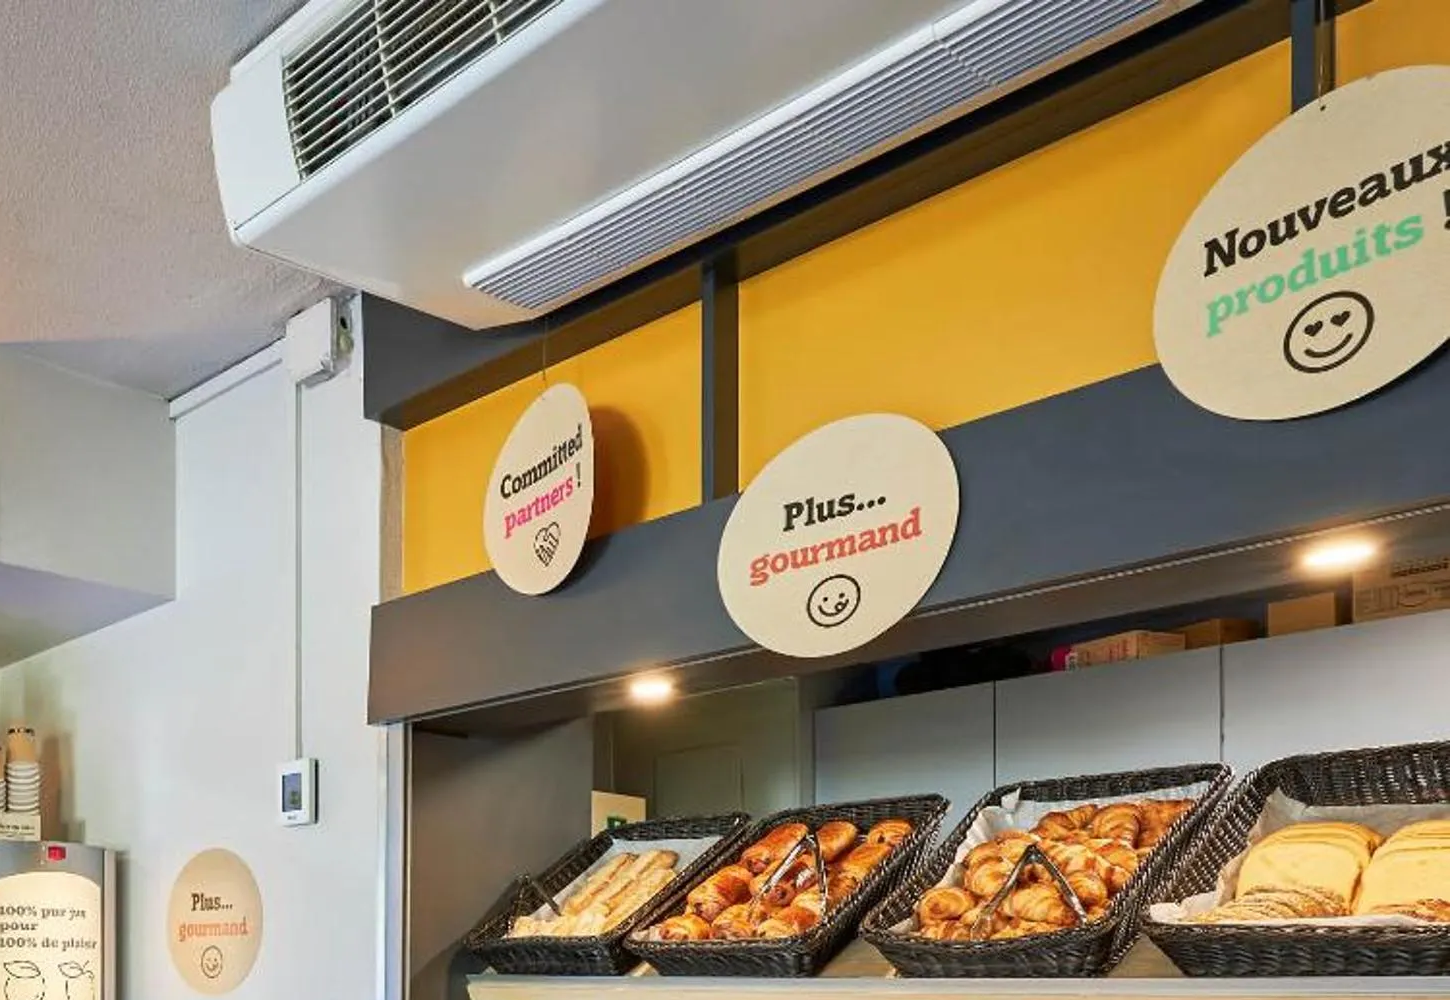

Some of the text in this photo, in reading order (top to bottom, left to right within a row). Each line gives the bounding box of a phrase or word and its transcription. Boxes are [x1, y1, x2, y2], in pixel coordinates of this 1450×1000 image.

[1203, 140, 1450, 277] Nouveaux
[1206, 214, 1425, 339] produits
[500, 422, 583, 499] Committed
[504, 475, 575, 540] partners
[782, 492, 887, 532] Plus...
[750, 505, 922, 588] gourmand
[0, 906, 37, 917] 100%
[41, 908, 66, 919] pur
[191, 892, 233, 912] Plus...
[0, 922, 39, 934] pour
[0, 937, 37, 948] 100%
[41, 937, 59, 948] de
[178, 916, 249, 942] gourmand
